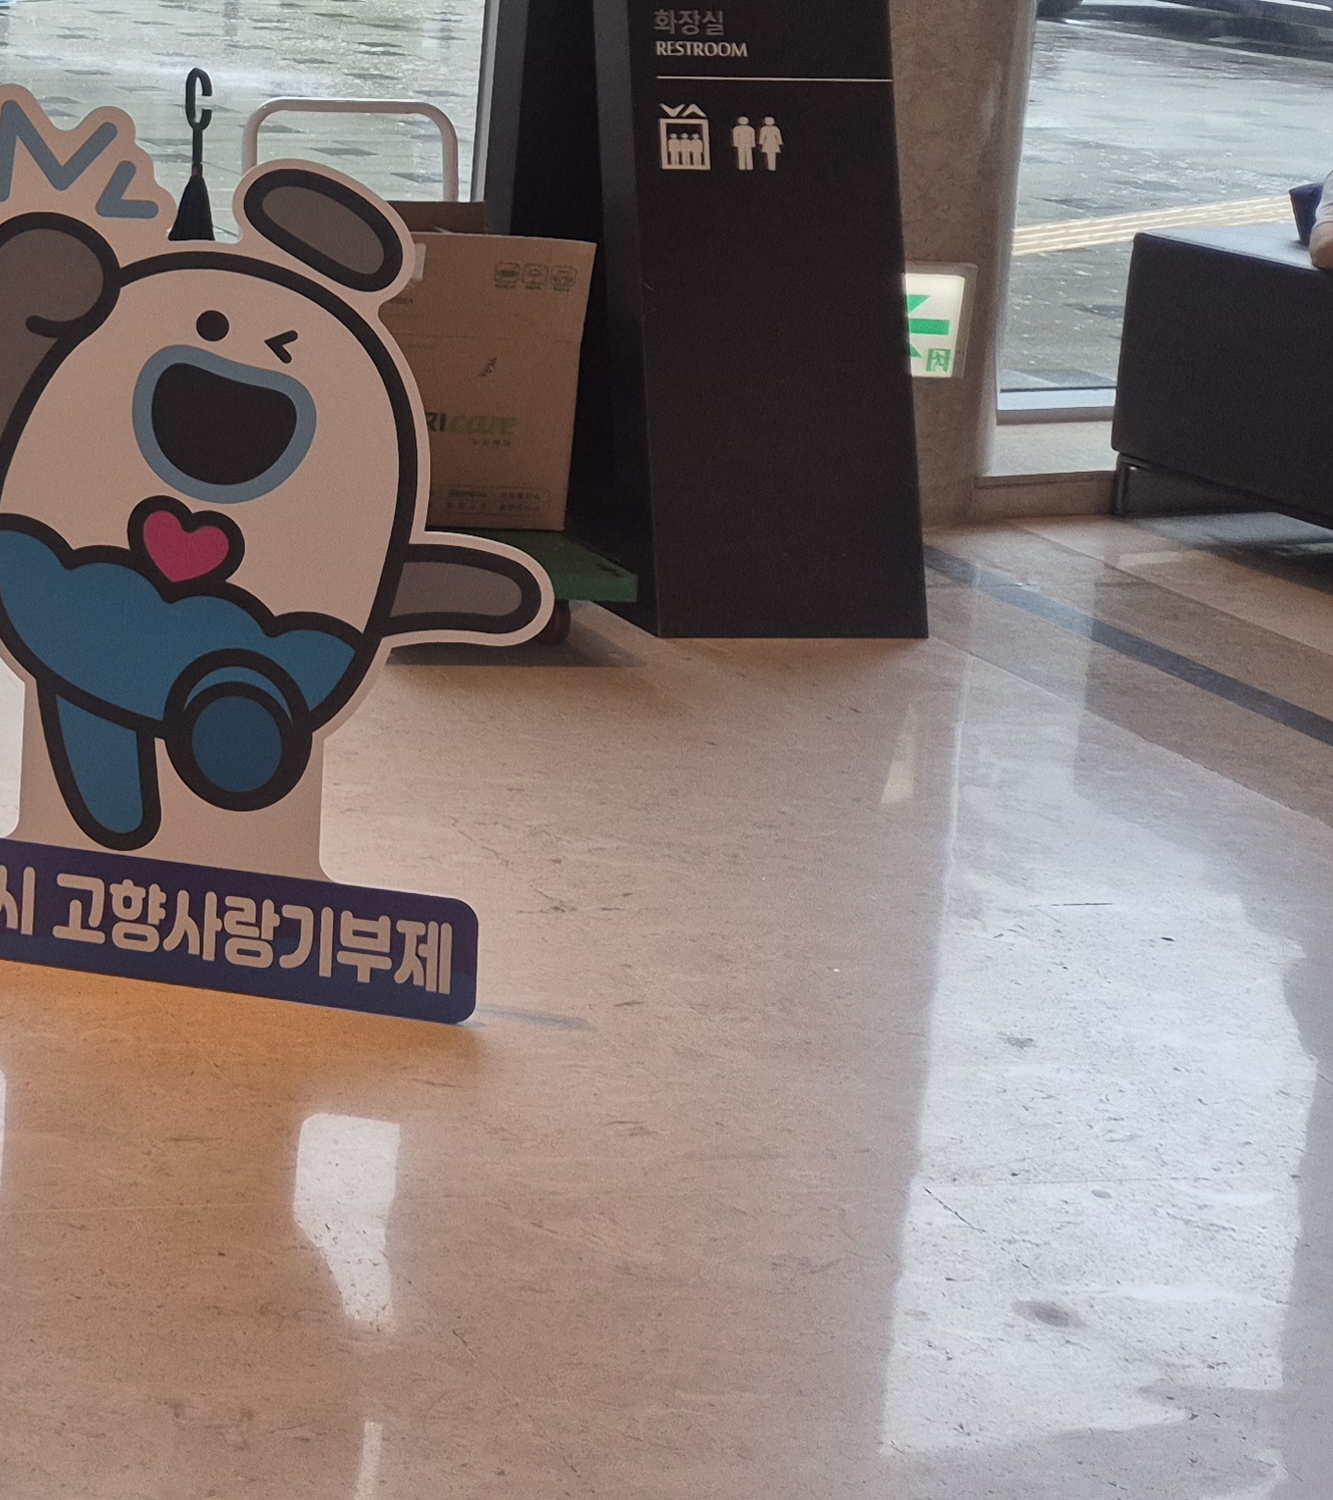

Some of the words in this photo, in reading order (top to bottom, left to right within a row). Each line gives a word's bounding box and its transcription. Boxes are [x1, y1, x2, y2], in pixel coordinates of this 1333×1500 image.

[653, 9, 725, 36] 화장실
[656, 41, 748, 58] RESTROOM
[52, 871, 452, 995] 고향사랑기부제
